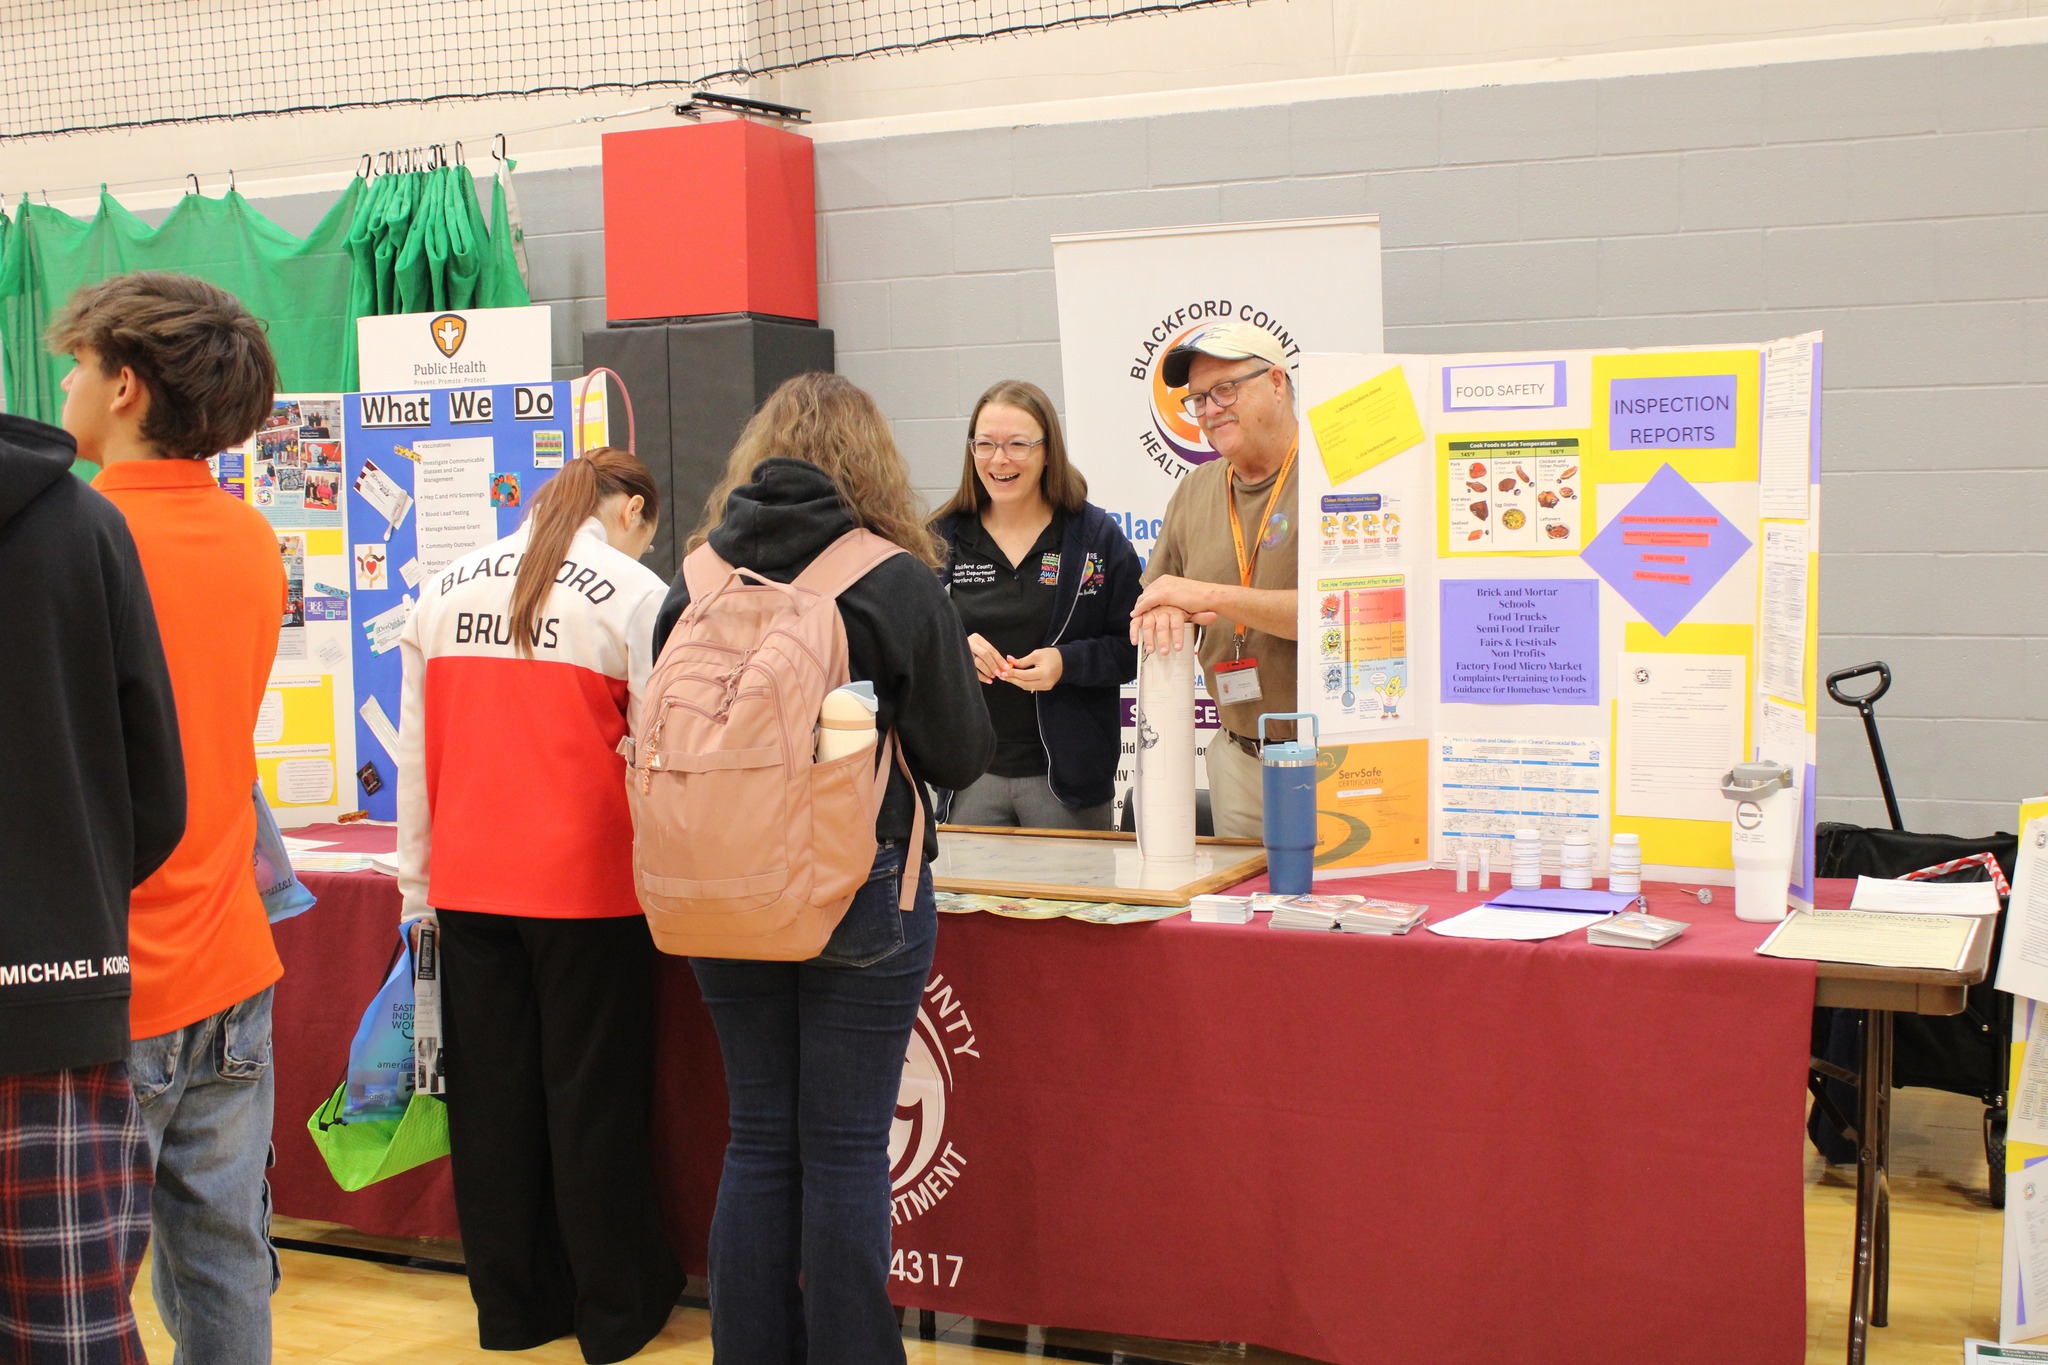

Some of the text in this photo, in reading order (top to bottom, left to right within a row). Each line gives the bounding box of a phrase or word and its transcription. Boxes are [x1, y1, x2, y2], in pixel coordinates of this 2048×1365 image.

[1130, 300, 1232, 381] BLACKFORD
[414, 361, 486, 375] Public Health
[1456, 383, 1545, 398] FOOD SAFETY
[363, 387, 553, 423] What We Do
[1614, 395, 1729, 414] INSPECTION
[1630, 426, 1715, 443] REPORTS
[1139, 431, 1190, 479] HEALT
[449, 457, 484, 465] Communicable
[441, 553, 616, 604] BLACORD
[1477, 588, 1558, 597] Brick and Mortar
[1499, 600, 1535, 608] Schools
[1488, 612, 1547, 621] Food Trucks
[456, 612, 559, 648] BRUNS
[1476, 624, 1560, 633] Semi Food Trailer
[1480, 638, 1556, 647] Fairs & Festivals
[1491, 649, 1546, 657] Non Profits
[1456, 662, 1582, 672] Factory Food Micro Market
[1453, 674, 1587, 684] Complaints Pertaining to Foods
[1453, 686, 1586, 694] Guidance for Homebase Vendors
[1339, 767, 1381, 779] ServSafe
[1338, 778, 1384, 788] CERTIFICATION
[0, 956, 129, 986] MICHAEL KORS
